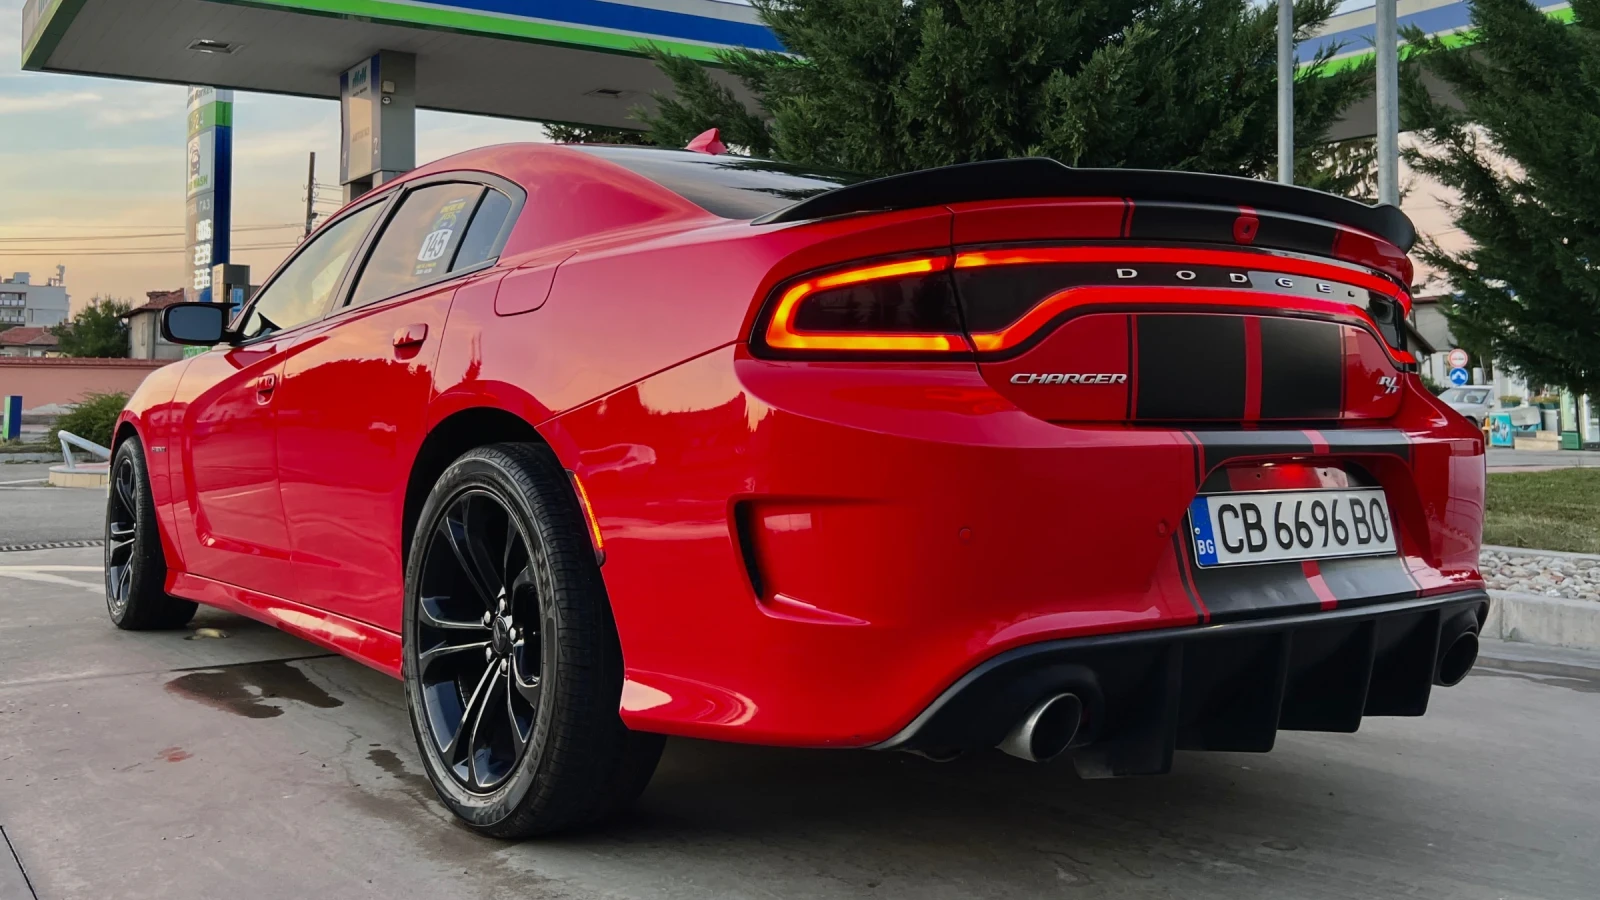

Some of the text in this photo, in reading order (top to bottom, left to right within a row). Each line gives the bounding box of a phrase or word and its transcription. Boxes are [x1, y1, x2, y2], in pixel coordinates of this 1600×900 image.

[421, 231, 449, 260] 145
[1116, 268, 1334, 294] DODGE
[1009, 372, 1128, 386] CHARGER
[1217, 502, 1268, 555] CB
[1273, 499, 1350, 551] 6696
[1197, 539, 1215, 556] BG
